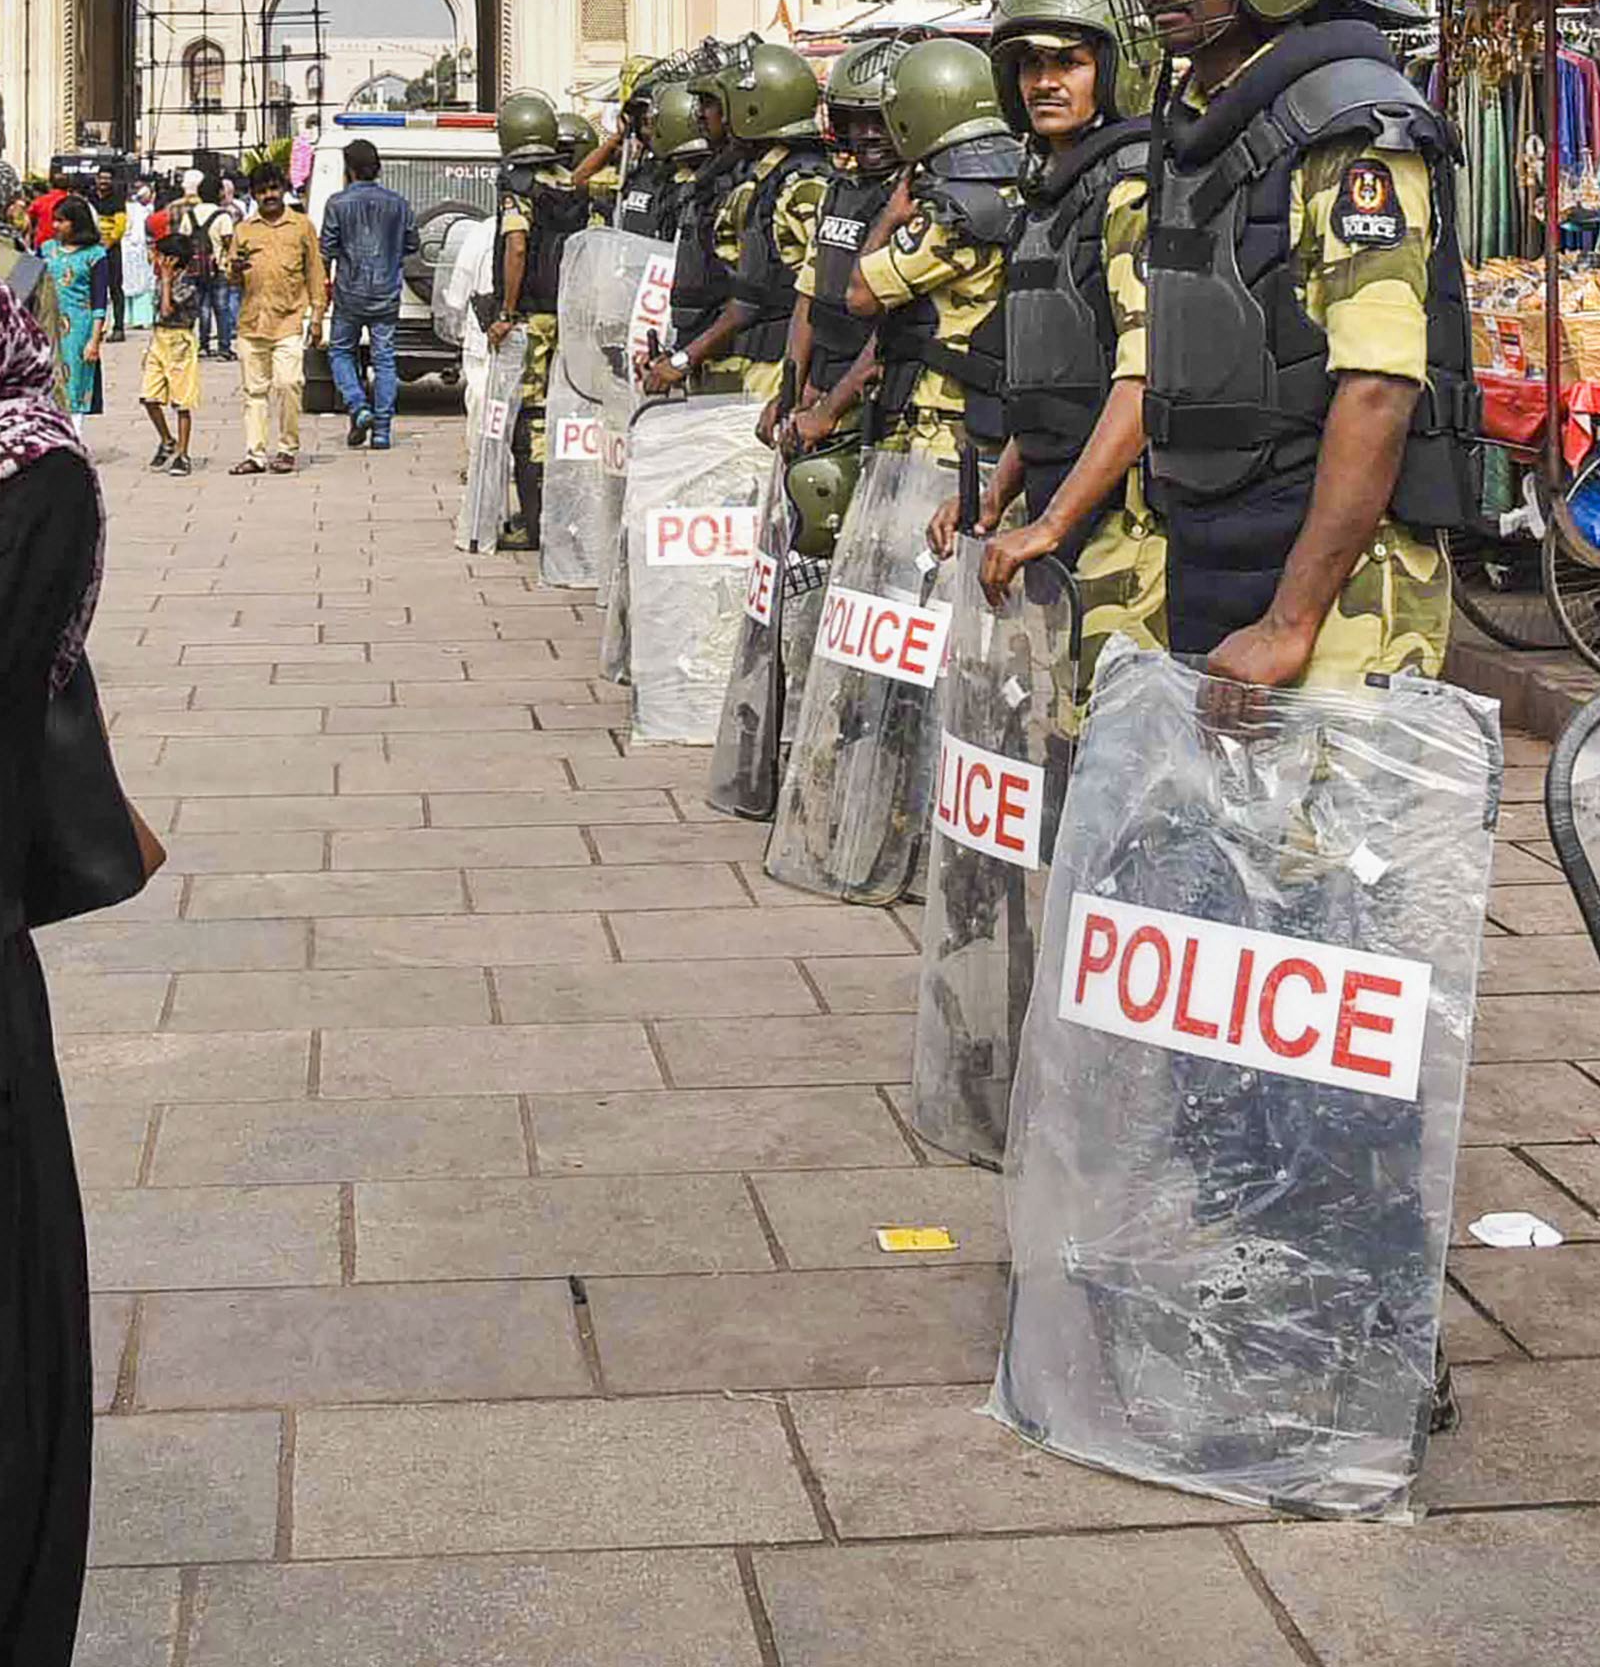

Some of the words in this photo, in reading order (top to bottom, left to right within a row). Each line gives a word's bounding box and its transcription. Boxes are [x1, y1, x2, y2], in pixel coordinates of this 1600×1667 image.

[445, 166, 498, 180] POLICE
[820, 219, 859, 244] POLICE
[1344, 221, 1396, 238] POLICE
[658, 515, 759, 557] POLI
[824, 594, 936, 675] POLICE
[937, 743, 1030, 852] LICE
[1075, 913, 1403, 1078] POLICE
